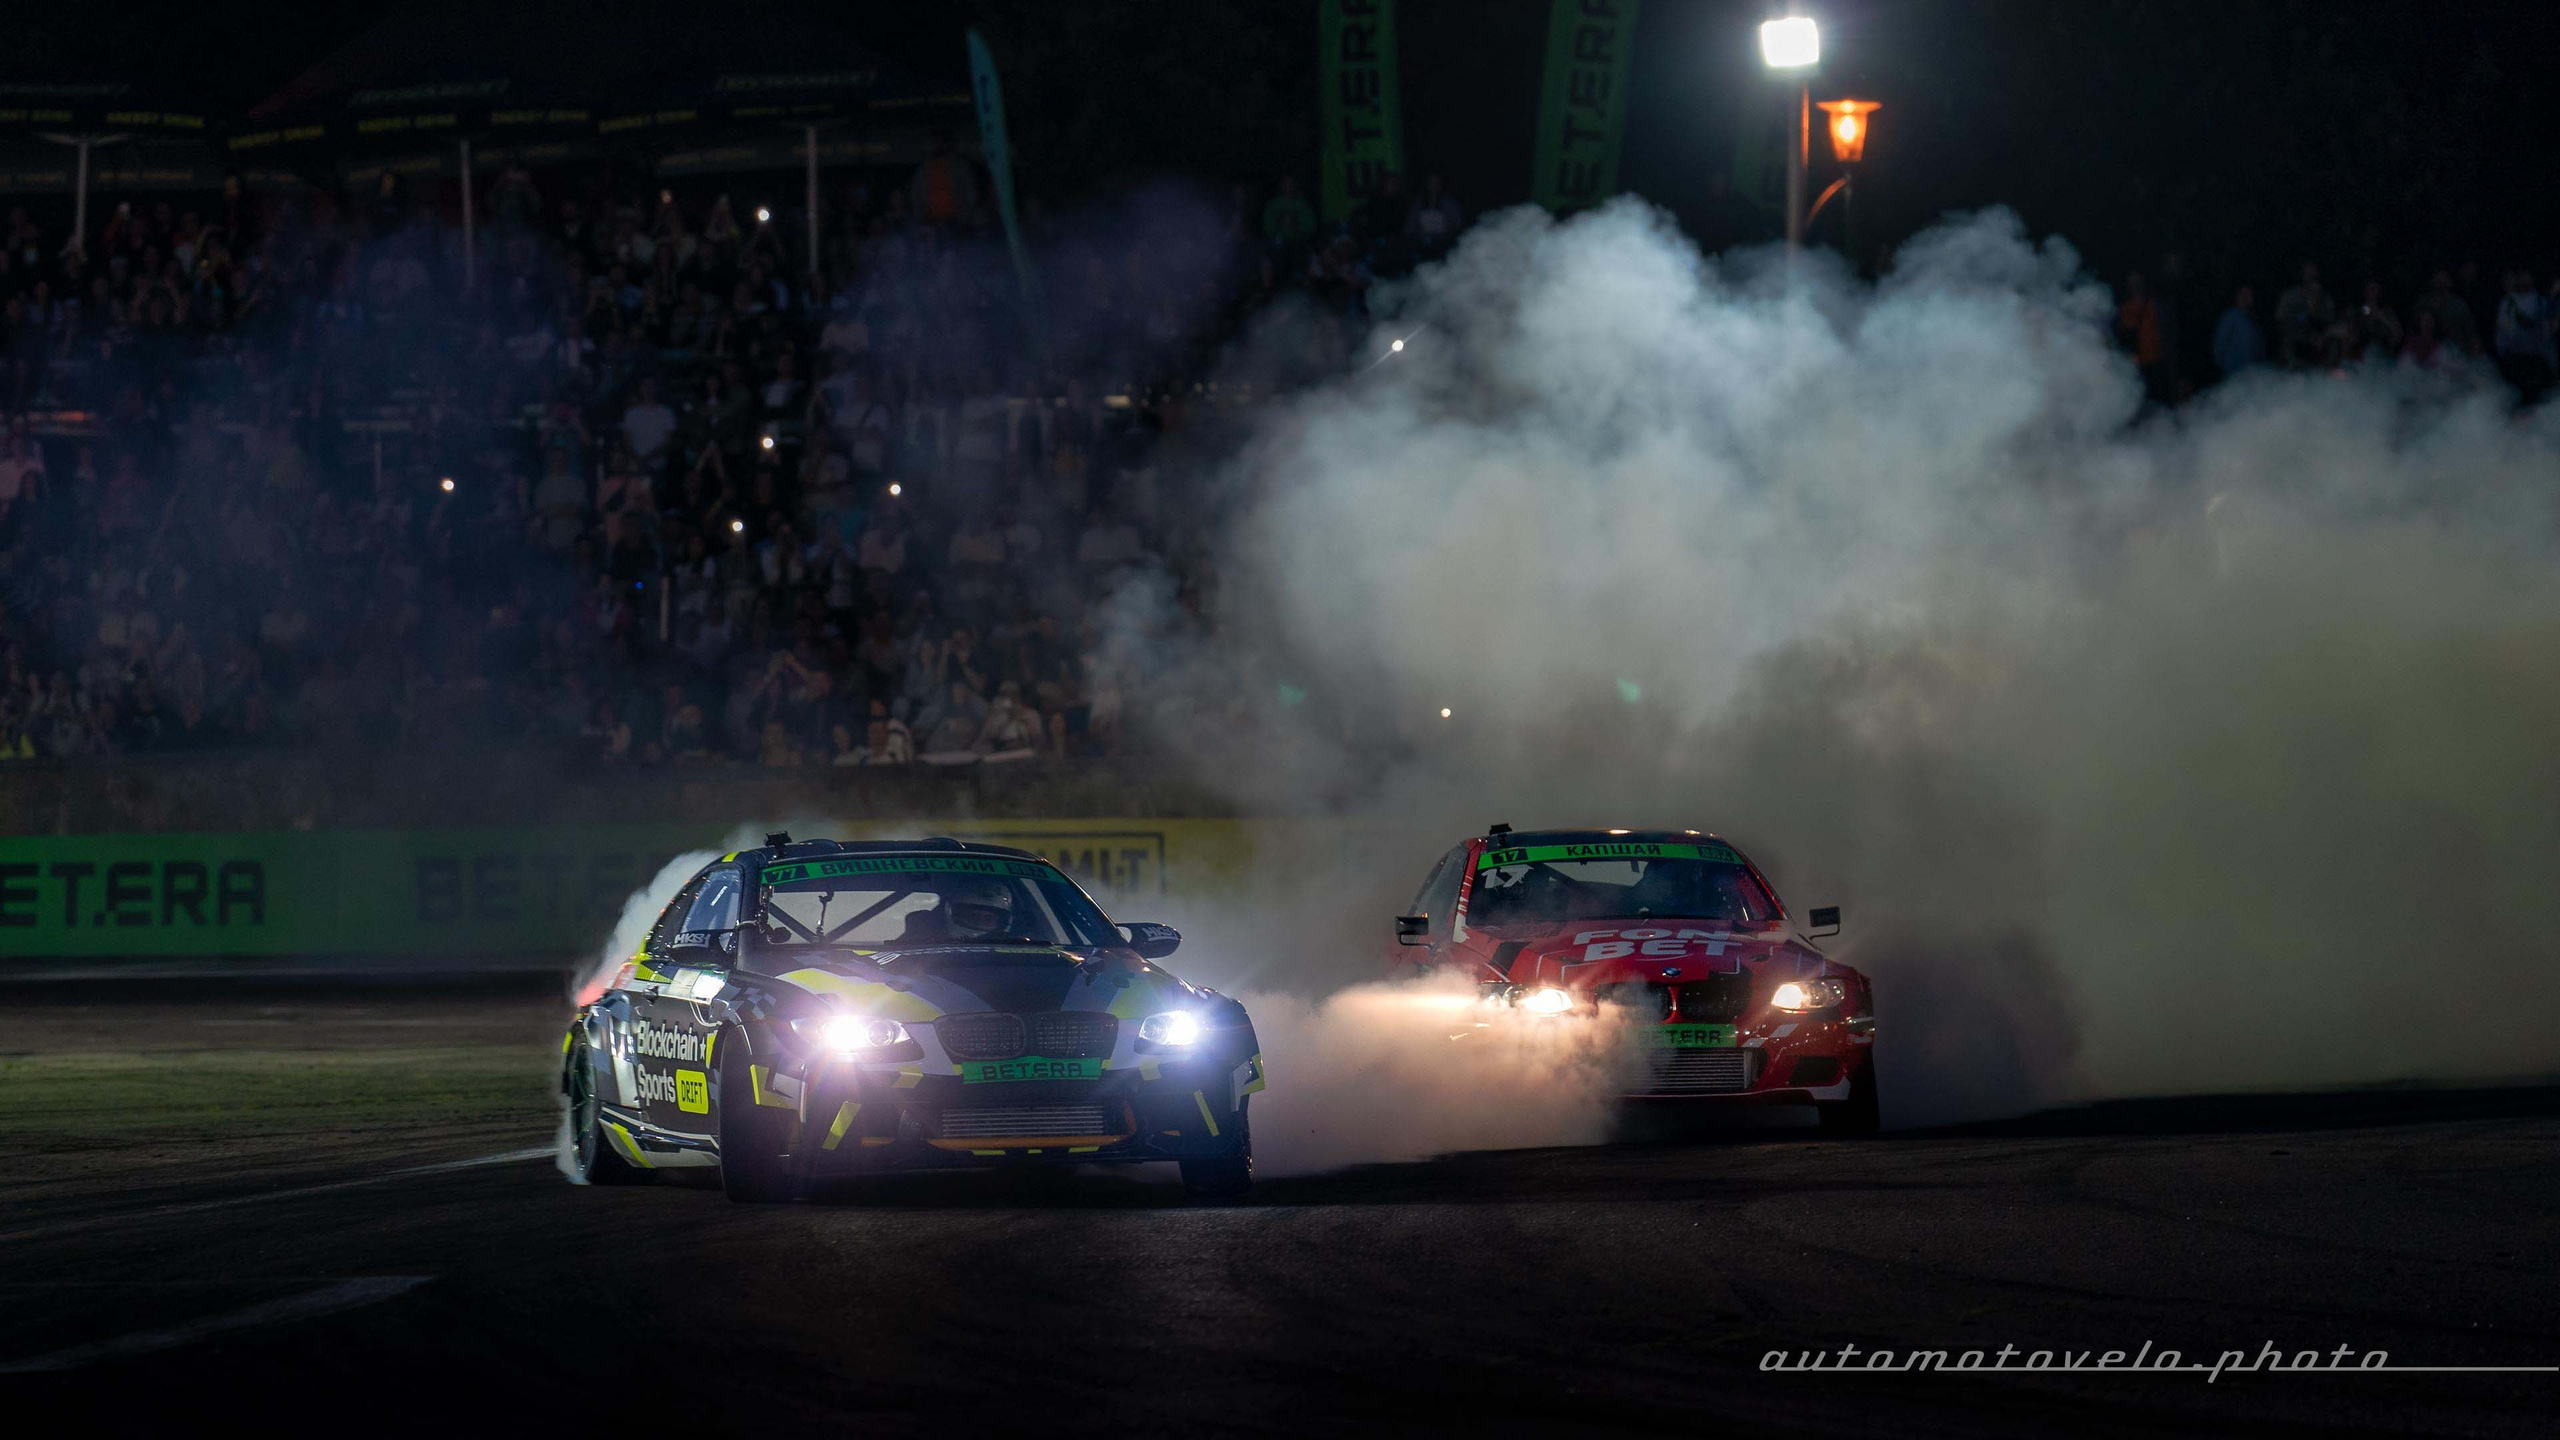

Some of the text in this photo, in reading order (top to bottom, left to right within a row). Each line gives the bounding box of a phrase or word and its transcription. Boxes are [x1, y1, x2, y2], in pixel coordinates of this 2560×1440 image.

[1499, 850, 1519, 861] 17
[1481, 864, 1534, 889] 17
[1573, 928, 1731, 945] FON
[1584, 940, 1742, 962] BET
[637, 1020, 699, 1061] Blockchain
[637, 1063, 704, 1106] Sports DRIFT
